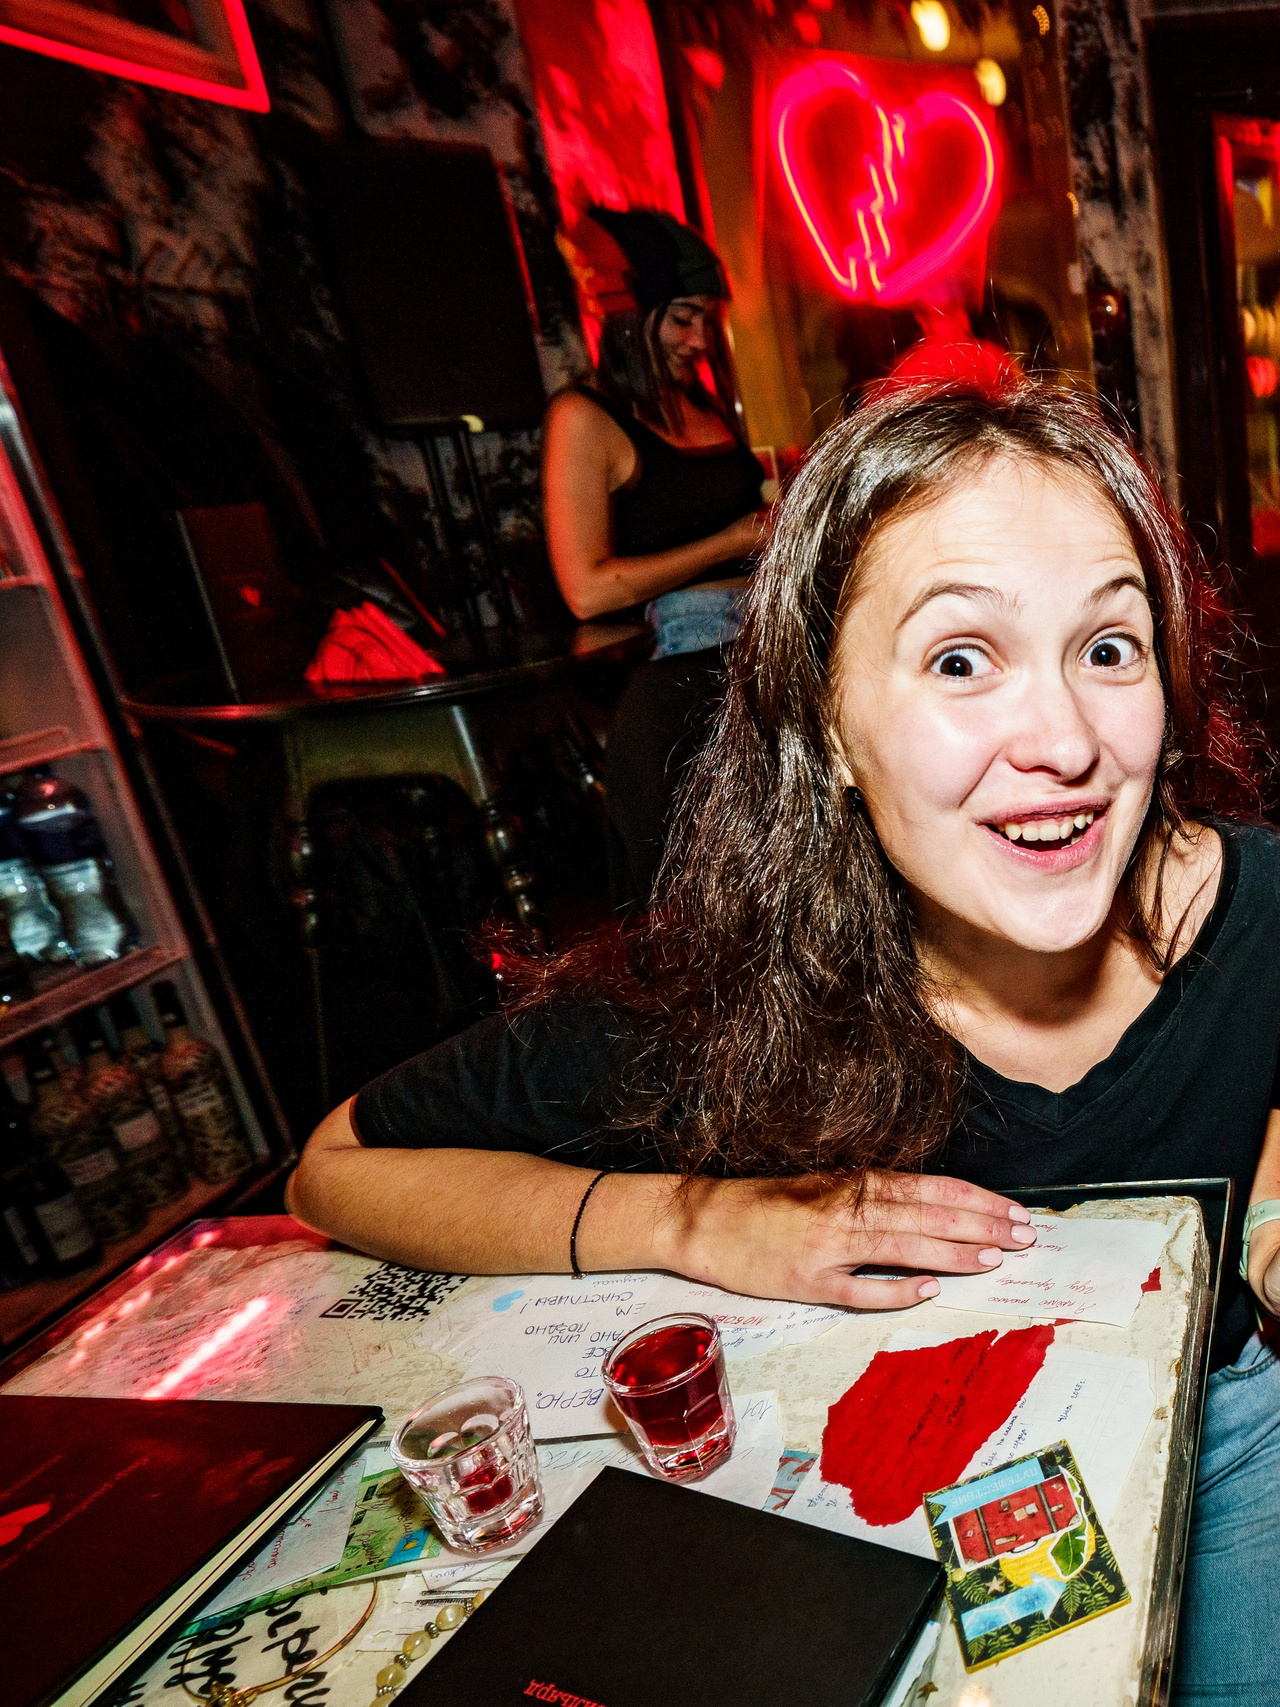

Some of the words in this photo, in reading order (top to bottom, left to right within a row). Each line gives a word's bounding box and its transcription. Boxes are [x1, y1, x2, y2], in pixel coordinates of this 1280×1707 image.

[1074, 1303, 1097, 1314] Я
[574, 1367, 602, 1379] ТО
[951, 1467, 1039, 1507] ПУТЕШЕСТВИЕ
